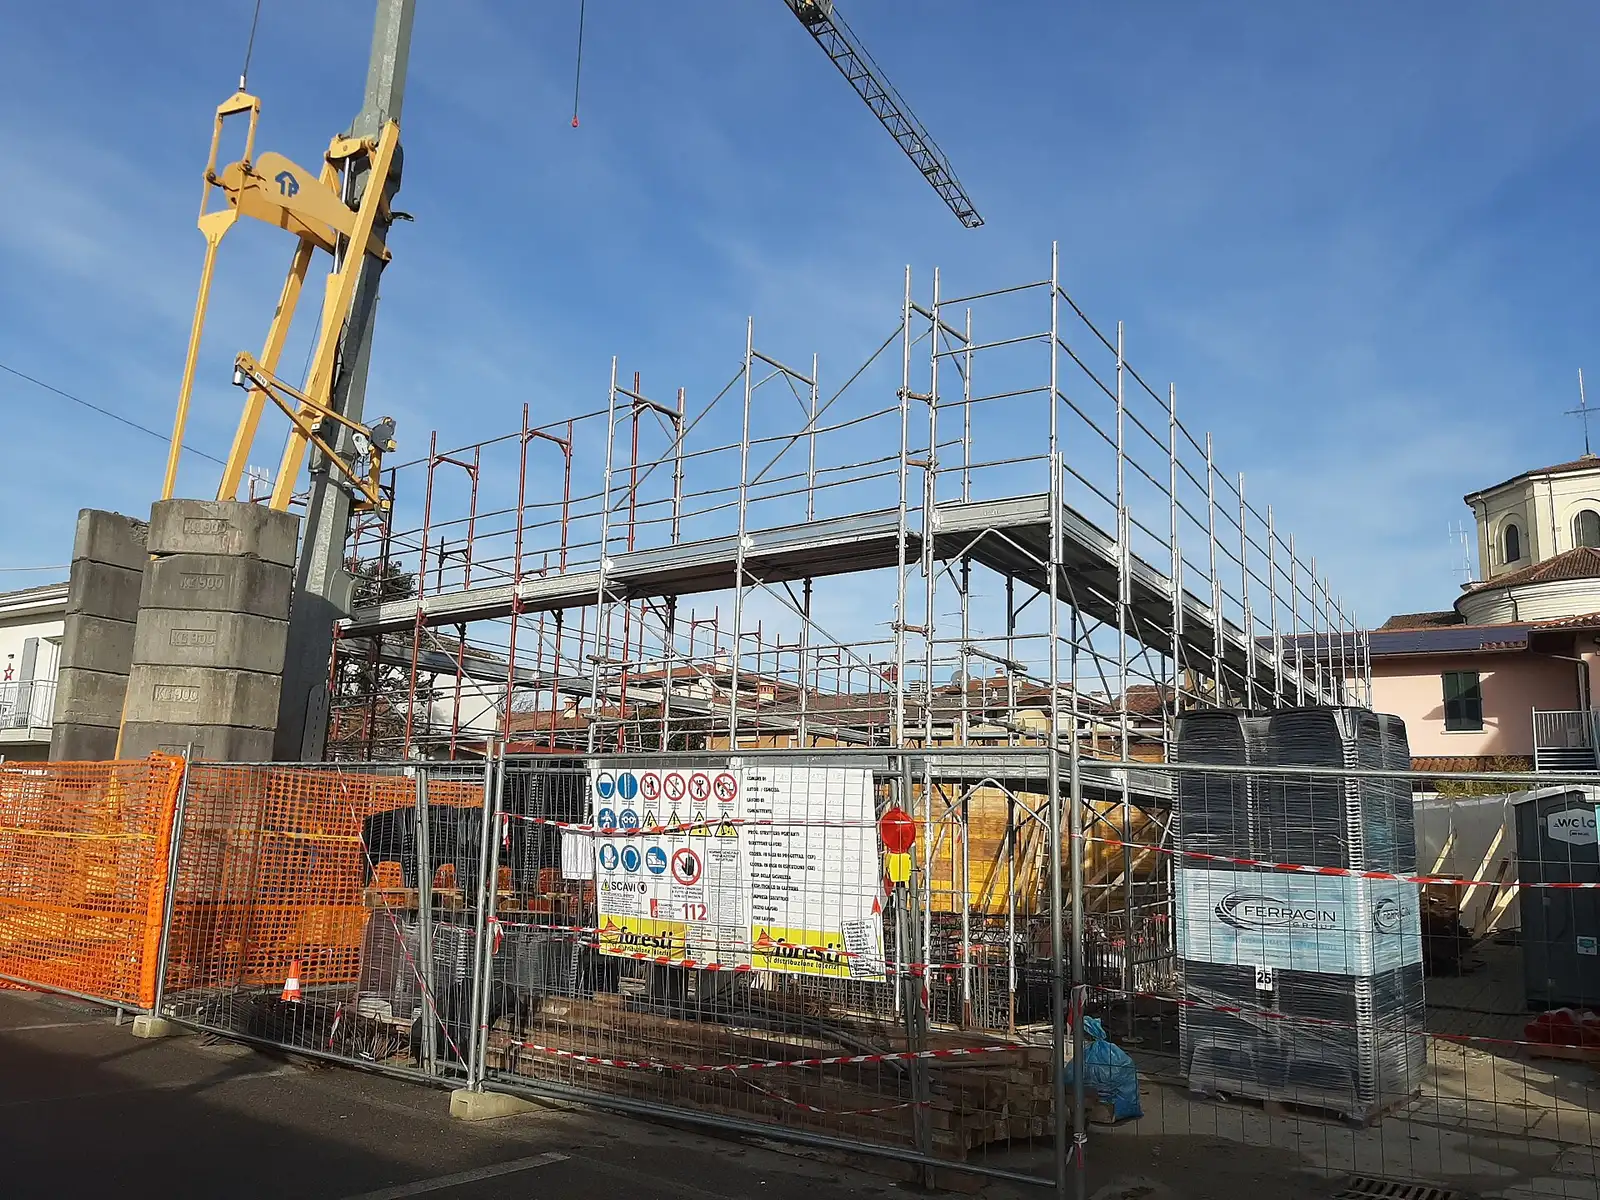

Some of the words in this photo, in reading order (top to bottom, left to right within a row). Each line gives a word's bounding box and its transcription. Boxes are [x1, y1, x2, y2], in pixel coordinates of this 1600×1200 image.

[173, 688, 199, 702] 900
[611, 880, 636, 893] SCAVI
[682, 903, 708, 921] 112
[1244, 905, 1336, 922] FERRACIN
[1257, 971, 1272, 984] 25
